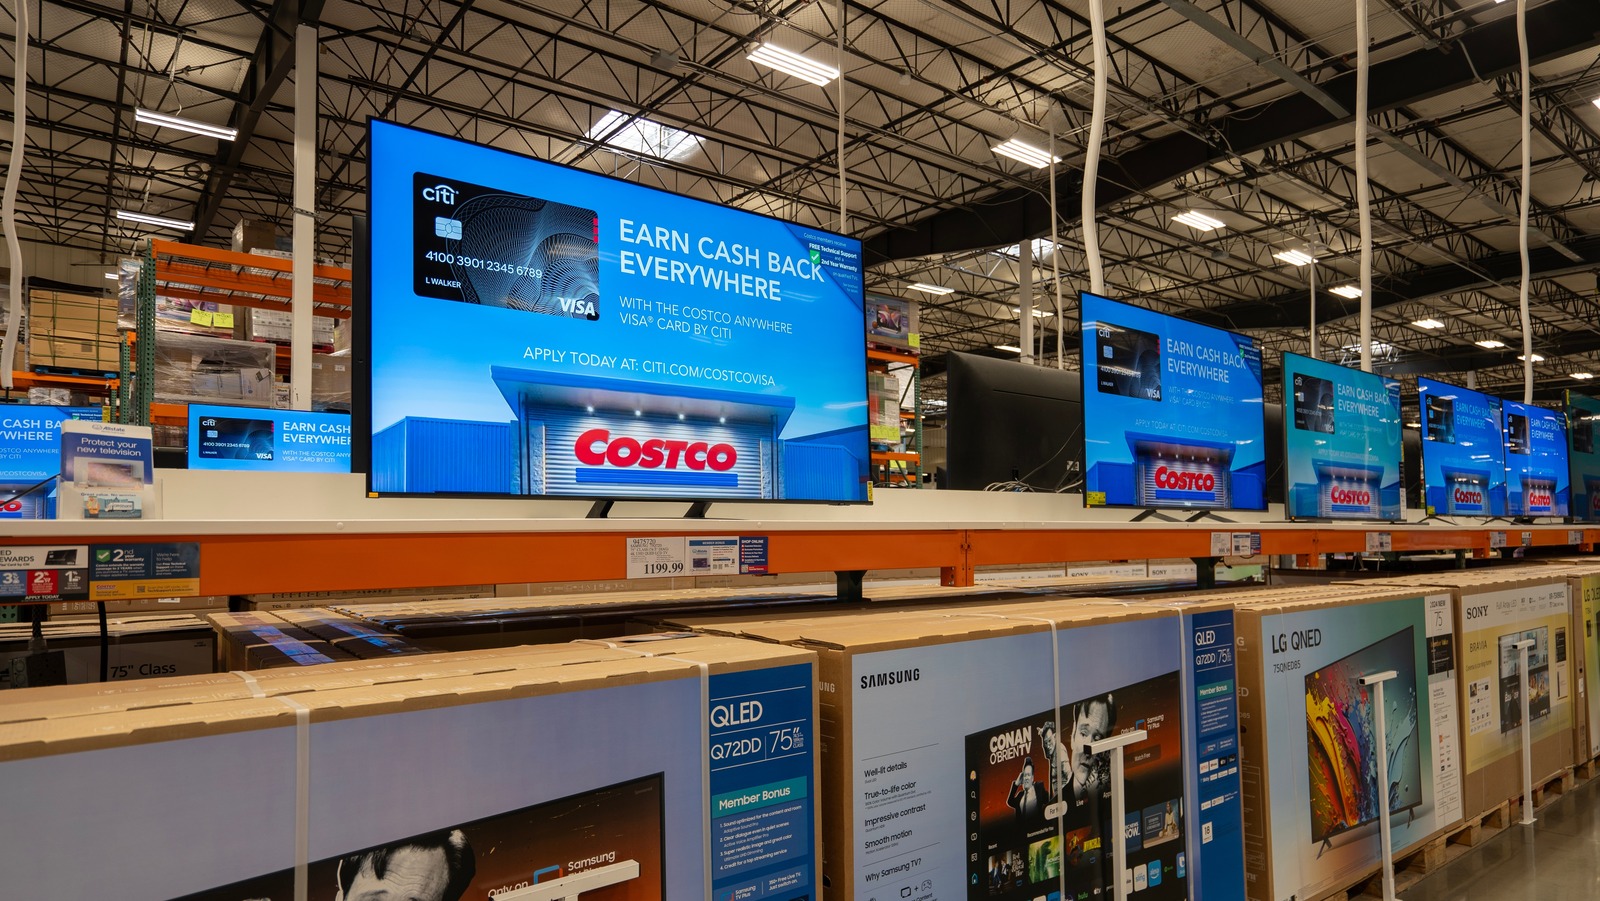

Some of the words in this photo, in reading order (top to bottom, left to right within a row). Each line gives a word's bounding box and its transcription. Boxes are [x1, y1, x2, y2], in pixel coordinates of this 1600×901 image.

[422, 184, 456, 205] citi
[620, 219, 689, 254] EARN
[698, 236, 760, 269] CASH
[768, 252, 824, 282] BACK
[821, 246, 840, 255] Technical
[841, 251, 857, 259] Support
[426, 251, 454, 264] 4100
[456, 256, 484, 269] 3901
[487, 261, 513, 274] 2345
[516, 266, 543, 278] 6789
[431, 278, 461, 288] WALKER
[620, 250, 781, 301] EVERYWHERE
[557, 296, 596, 316] VISA
[620, 296, 652, 311] WITH
[656, 302, 679, 316] THE
[682, 306, 731, 324] COSTCO
[734, 316, 792, 334] ANYWHERE
[657, 318, 690, 333] CARD
[694, 324, 708, 336] BY
[711, 326, 732, 339] CITI
[1167, 338, 1194, 357] EARN
[1196, 345, 1221, 362] CASH
[1223, 352, 1246, 369] BACK
[524, 347, 566, 363] APPLY
[570, 352, 617, 368] TODAY
[620, 359, 638, 371] AT:
[642, 360, 775, 386] CITI.COM/COSTCOVISA
[1168, 358, 1230, 383] EVERYWHERE
[1147, 388, 1160, 399] VISA
[1338, 384, 1355, 399] EARN
[1356, 388, 1373, 400] CASH
[1338, 399, 1380, 418] EVERYWHERE
[3, 419, 40, 429] CASH
[45, 420, 61, 429] BA
[202, 419, 216, 427] citi
[283, 421, 315, 432] EARN
[320, 424, 350, 434] CASH
[77, 446, 97, 454] new
[100, 447, 141, 456] television
[81, 438, 115, 447] Protect
[117, 441, 137, 449] your
[574, 428, 738, 472] COSTCO
[1155, 466, 1215, 492] COSTCO
[1331, 485, 1370, 505] COSTCO
[1454, 488, 1482, 504] COSTCO
[1529, 492, 1551, 506] COSTCO
[113, 549, 134, 562] 2nd
[644, 563, 684, 574] 1199.99
[1467, 605, 1488, 620] SONY
[1195, 630, 1215, 646] QLED
[1272, 633, 1287, 654] LG
[1291, 629, 1321, 650] QNED
[1470, 640, 1487, 652] BRAVIA
[1196, 653, 1216, 665] Q72DD
[1273, 660, 1301, 673] 75QNED85
[111, 665, 134, 678] 75"
[139, 663, 176, 676] Class
[860, 668, 920, 689] SAMSUNG
[1200, 688, 1216, 696] Member
[710, 700, 763, 728] QLED
[1147, 714, 1164, 724] Samsung
[769, 726, 799, 753] 75"
[990, 726, 1032, 752] CONAN
[711, 737, 762, 760] Q72DD
[864, 765, 886, 777] Well-lit
[887, 761, 907, 772] details
[719, 792, 760, 810] Member
[762, 786, 791, 801] Bonus
[864, 785, 900, 800] True-to-life
[900, 781, 916, 790] color
[864, 812, 899, 827] Impressive
[900, 804, 926, 816] contrast
[735, 831, 751, 839] dialogue
[865, 836, 890, 848] Smooth
[890, 829, 912, 840] motion
[751, 842, 763, 850] image
[568, 850, 615, 871] Samsung
[754, 853, 773, 861] streaming
[865, 871, 880, 882] Why
[881, 861, 910, 878] Samsung
[910, 858, 922, 867] TV?
[1136, 874, 1145, 882] sling
[736, 885, 756, 895] Samsung
